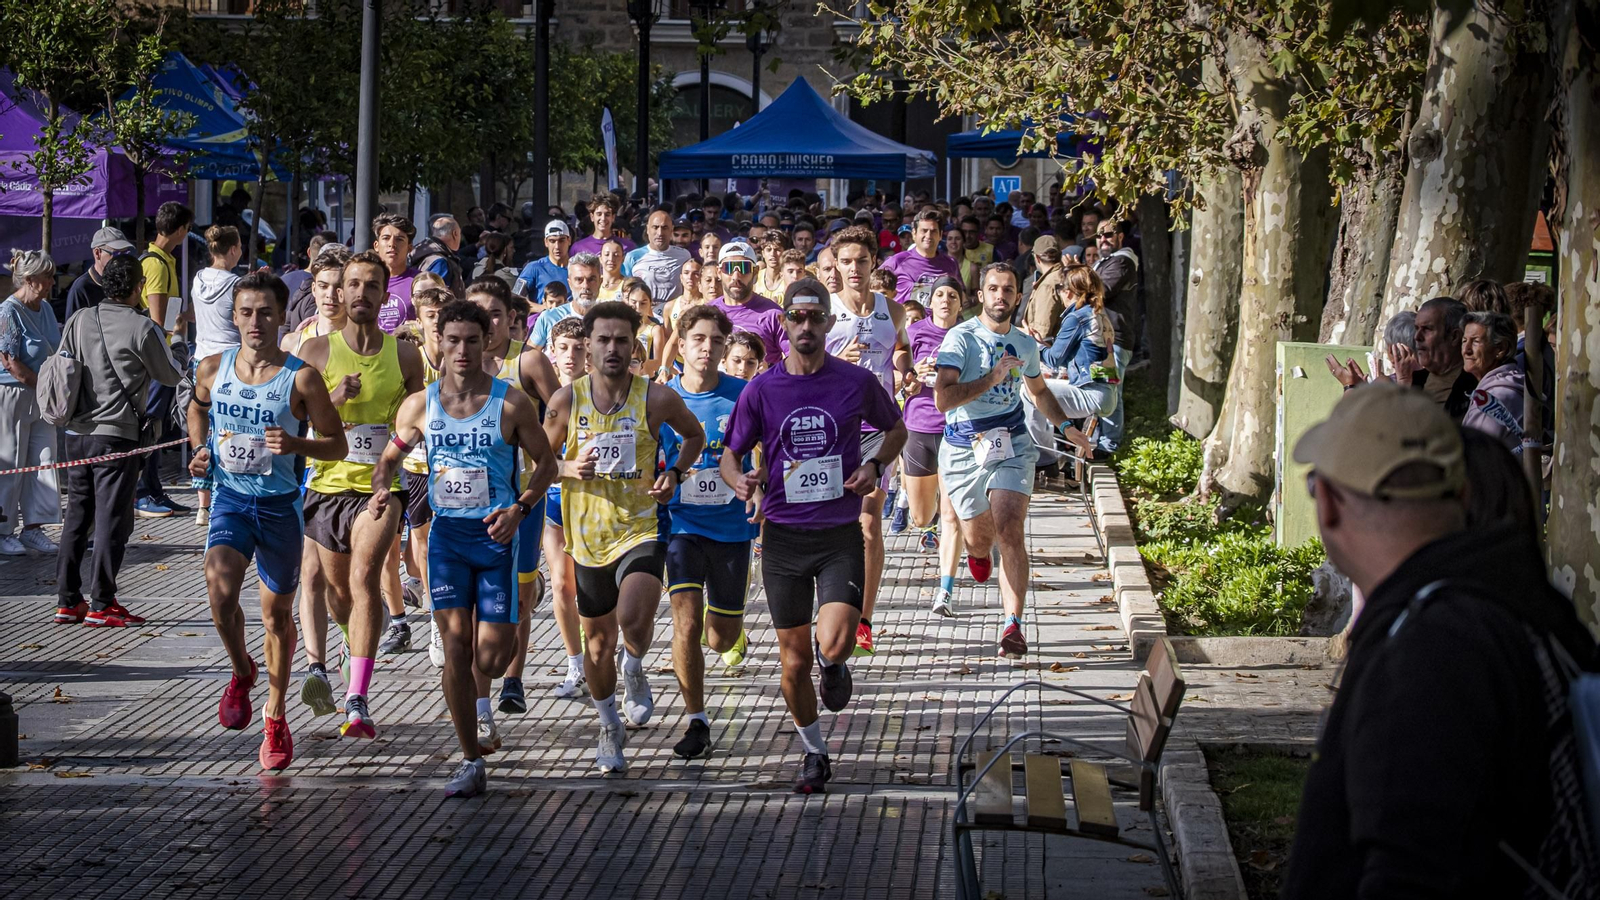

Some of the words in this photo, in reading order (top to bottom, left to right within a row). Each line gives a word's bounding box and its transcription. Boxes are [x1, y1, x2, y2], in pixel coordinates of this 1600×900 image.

[184, 92, 214, 111] OLIMPO
[9, 180, 33, 192] Cádiz
[997, 179, 1018, 193] AT
[216, 400, 276, 426] nerja
[790, 414, 825, 431] 25N
[354, 436, 373, 450] 35
[431, 427, 493, 451] nerja
[228, 445, 256, 461] 324
[444, 480, 472, 494] 325
[698, 480, 717, 493] 90
[799, 471, 829, 488] 299
[431, 584, 455, 594] nerja
